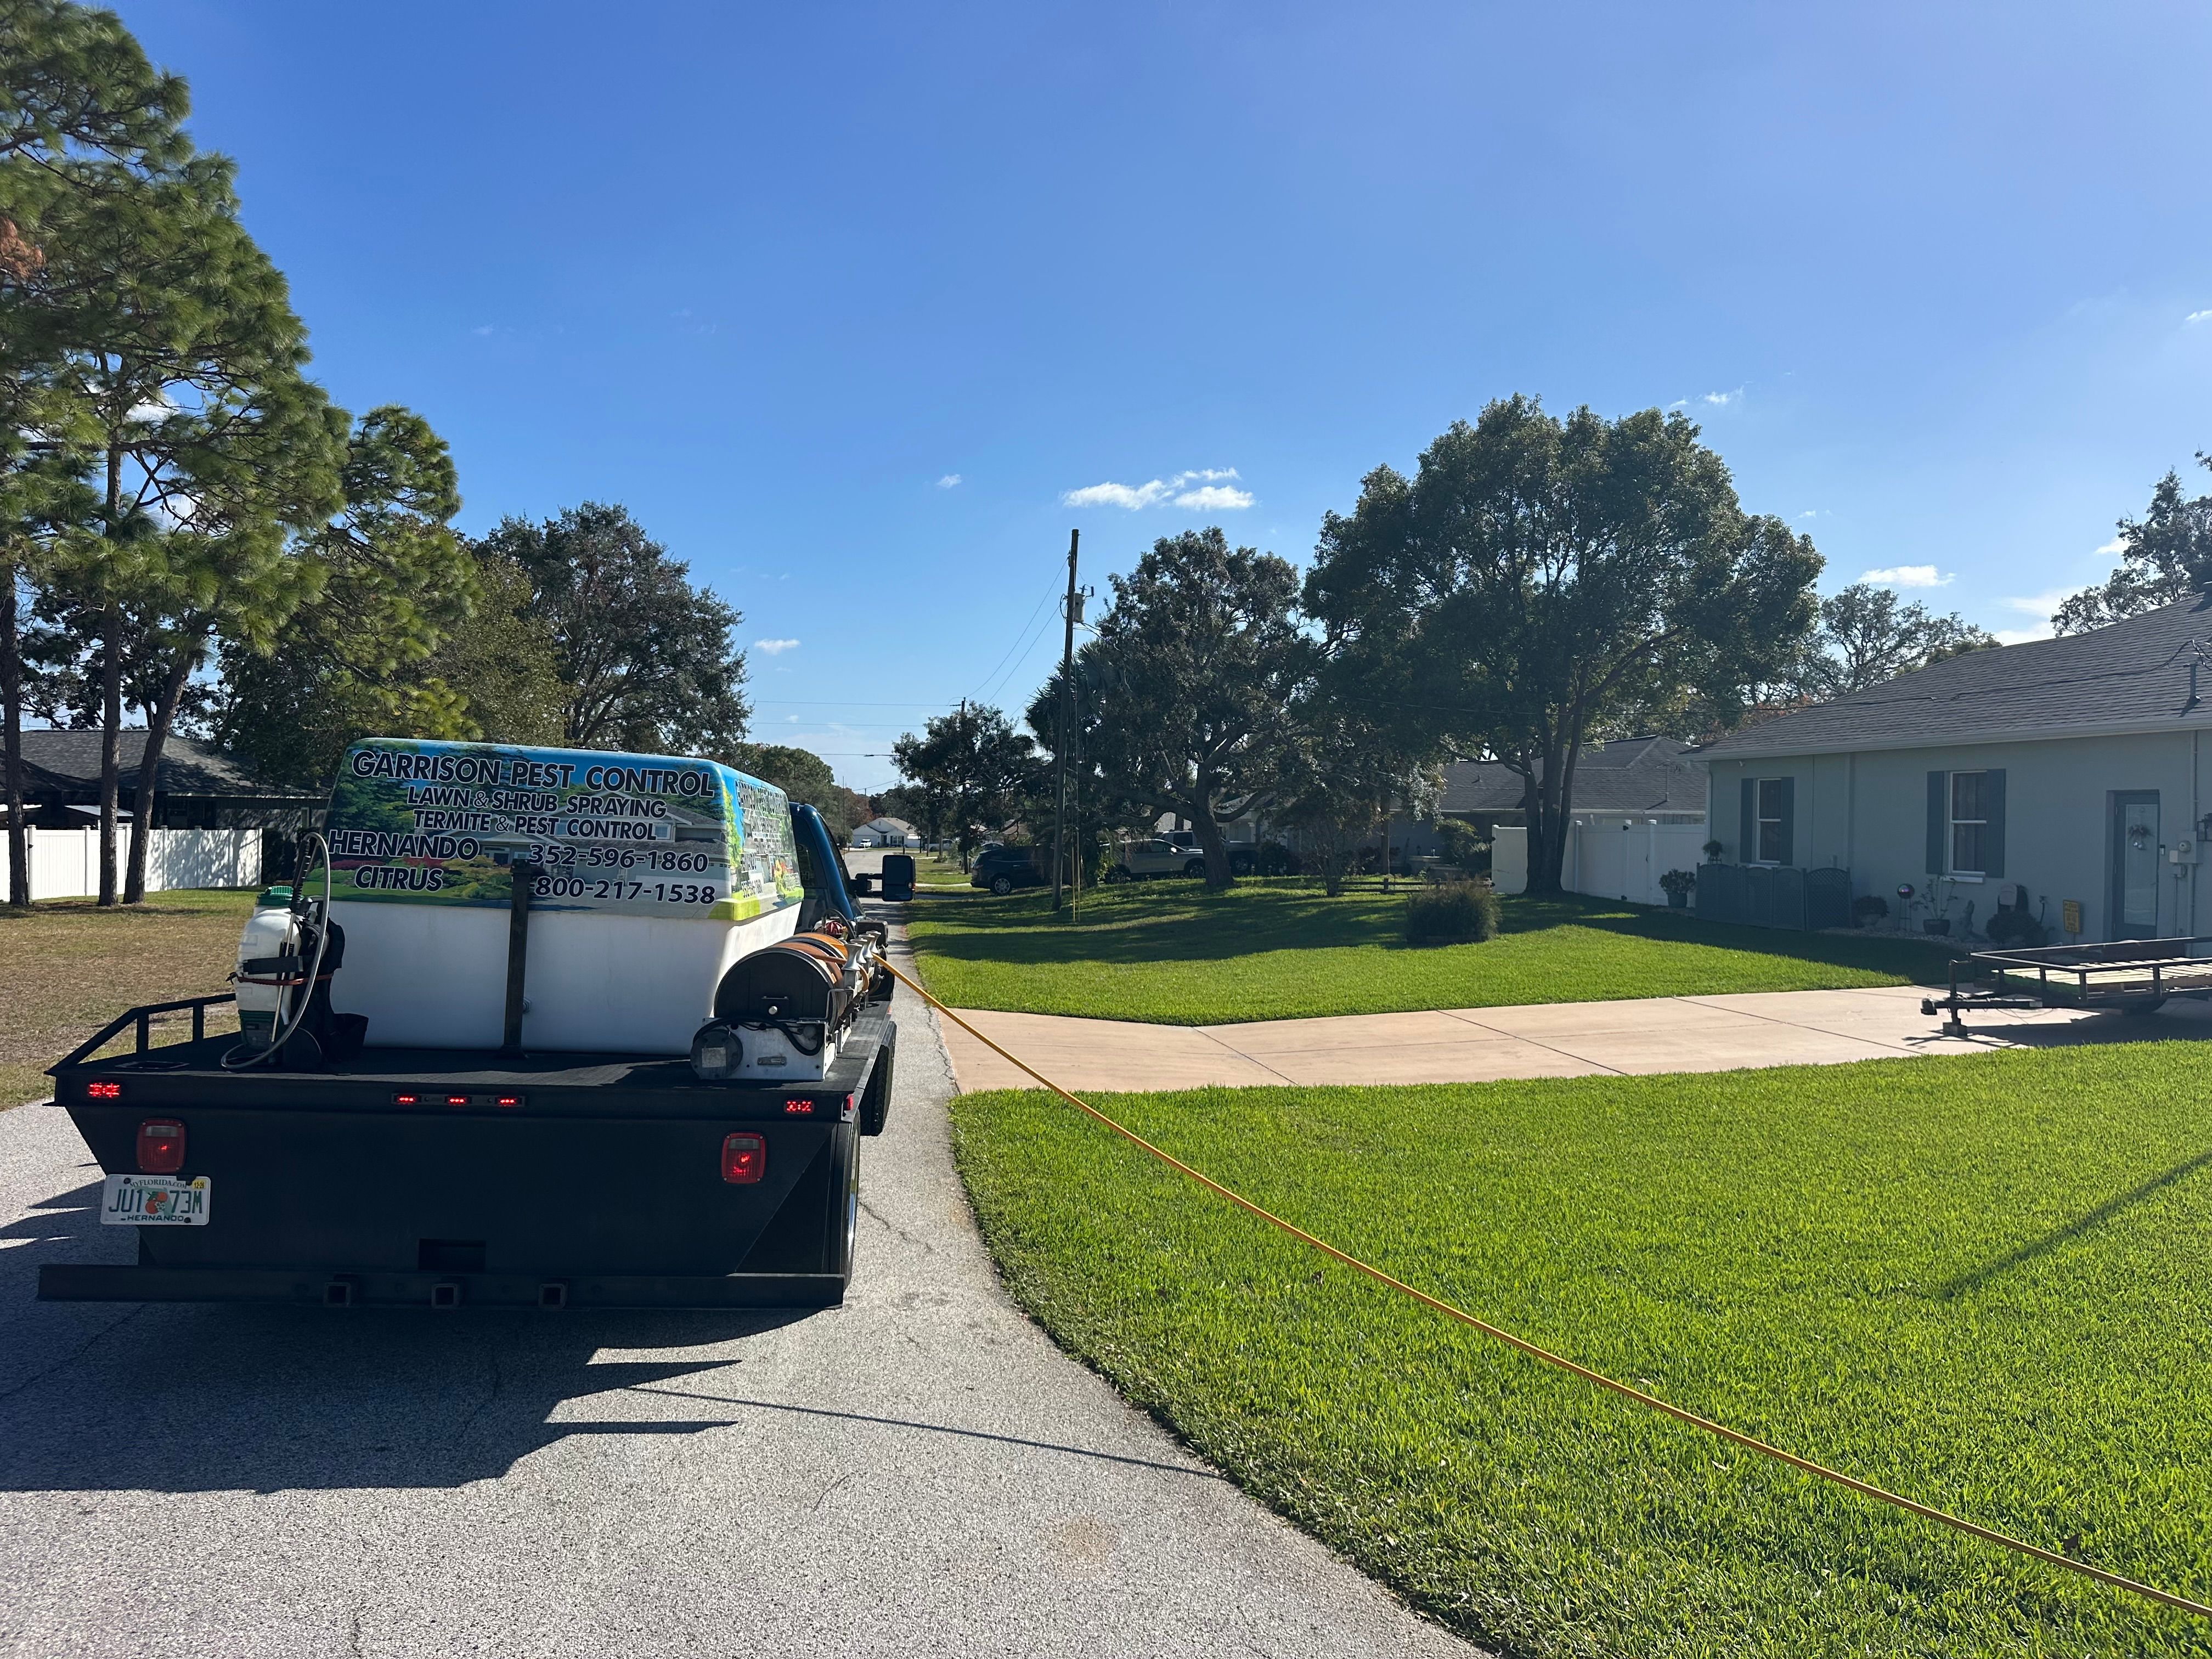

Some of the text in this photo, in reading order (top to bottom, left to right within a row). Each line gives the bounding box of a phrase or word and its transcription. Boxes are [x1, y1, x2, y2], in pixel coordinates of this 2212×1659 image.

[352, 751, 500, 785] GARRISON
[510, 761, 575, 789] PEST
[585, 765, 714, 798] CONTROL
[407, 786, 667, 819] LAWN & SHRUB SPRAYING
[413, 809, 657, 840] TERMITE & PEST CONTROL
[329, 830, 480, 861] HERNANDO
[529, 844, 709, 873] 352-596-1860
[354, 865, 443, 892] CITRUS
[529, 876, 715, 905] -800-217-1538
[109, 1189, 202, 1214] JU1 73M
